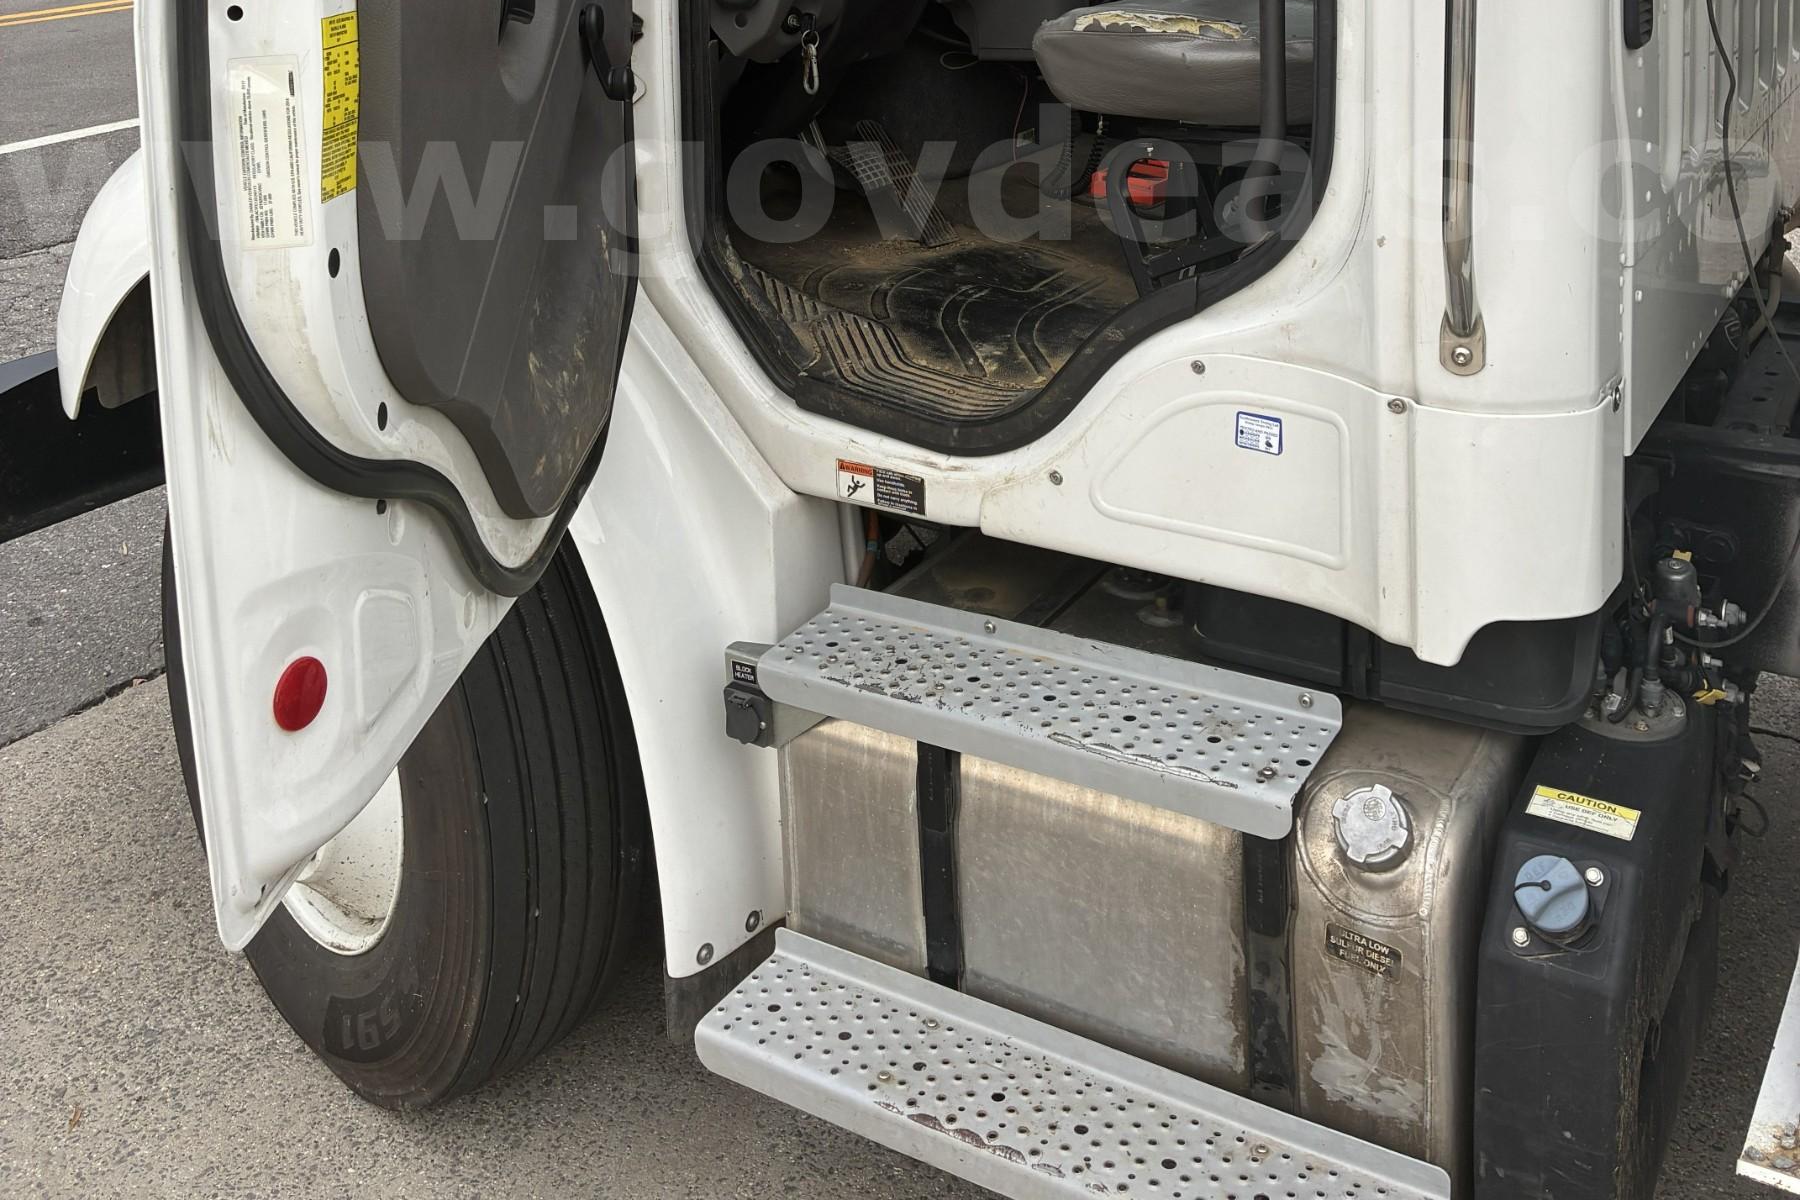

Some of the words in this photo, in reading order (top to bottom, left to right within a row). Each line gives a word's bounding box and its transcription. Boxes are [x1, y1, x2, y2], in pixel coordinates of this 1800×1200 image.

[736, 664, 752, 674] BLOCK
[734, 671, 754, 681] HEATER
[1557, 792, 1617, 813] CAUTION
[1369, 940, 1389, 955] LOW
